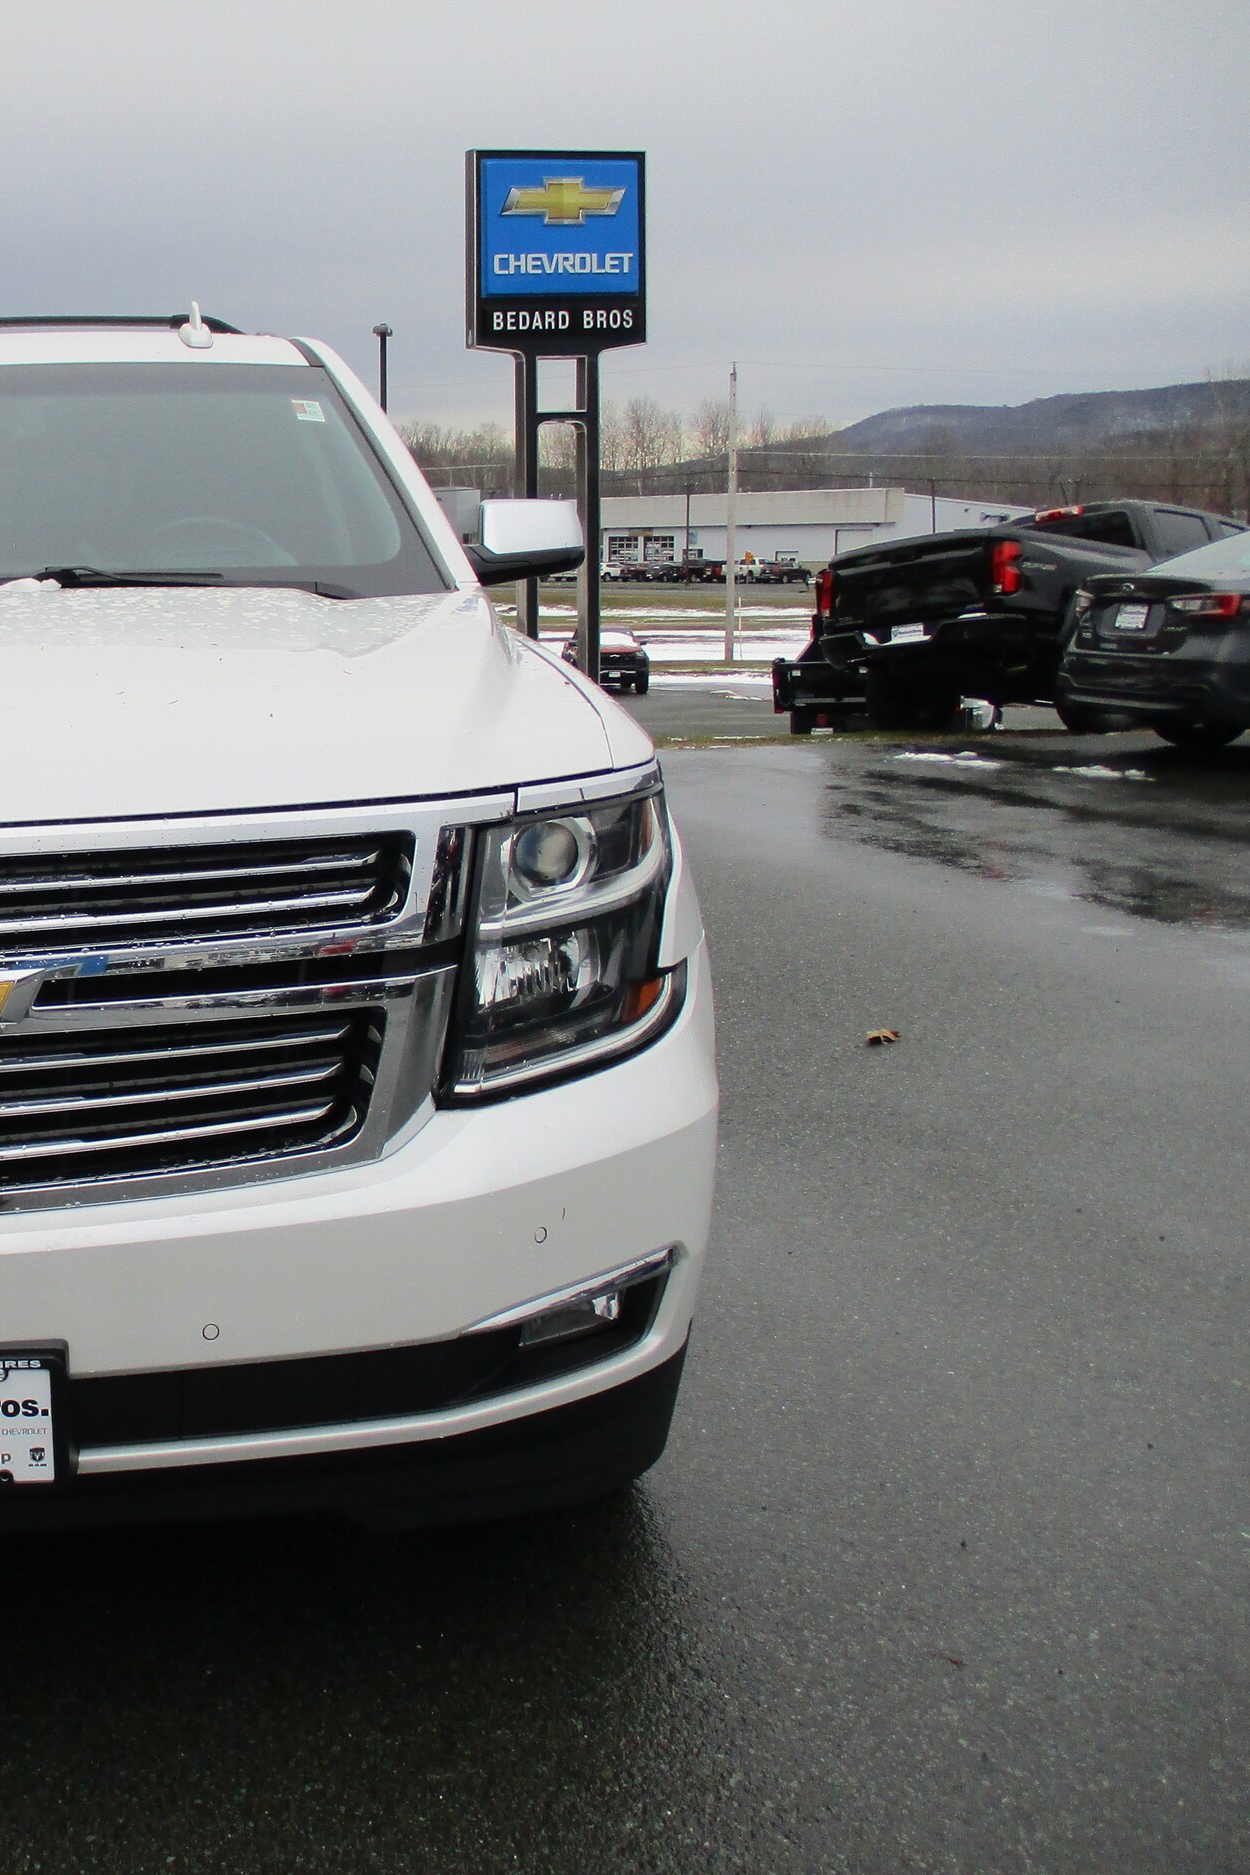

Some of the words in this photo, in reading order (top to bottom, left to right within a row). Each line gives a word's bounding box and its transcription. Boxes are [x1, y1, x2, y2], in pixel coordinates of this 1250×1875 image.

[493, 253, 634, 275] CHEVROLET
[493, 311, 570, 331] BEDARD
[583, 309, 634, 329] BROS
[1, 1427, 47, 1436] CHEVROLET
